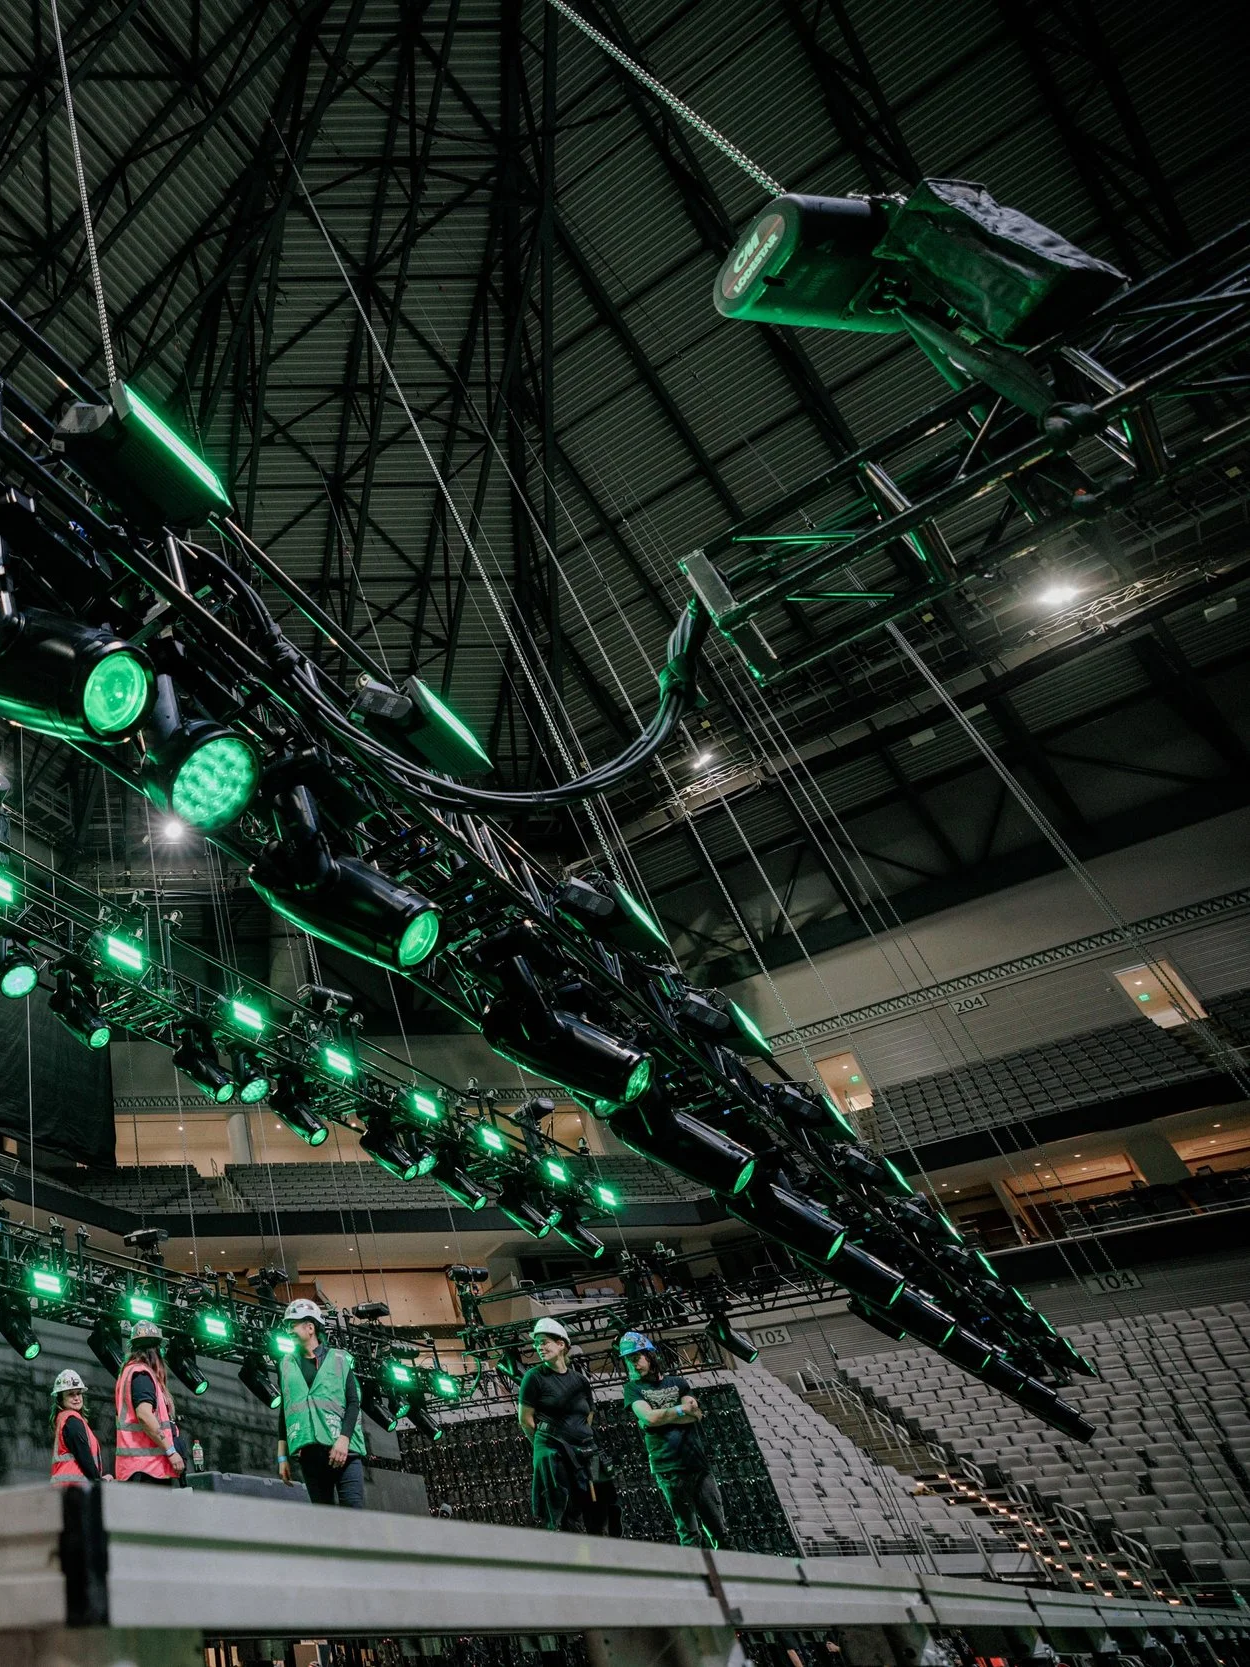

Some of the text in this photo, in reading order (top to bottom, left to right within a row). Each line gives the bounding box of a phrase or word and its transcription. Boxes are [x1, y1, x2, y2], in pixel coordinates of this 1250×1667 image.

[734, 232, 759, 273] CM
[733, 233, 778, 293] LODESTAR
[954, 996, 982, 1011] 204
[1093, 1272, 1134, 1291] 104
[756, 1329, 785, 1345] 103
